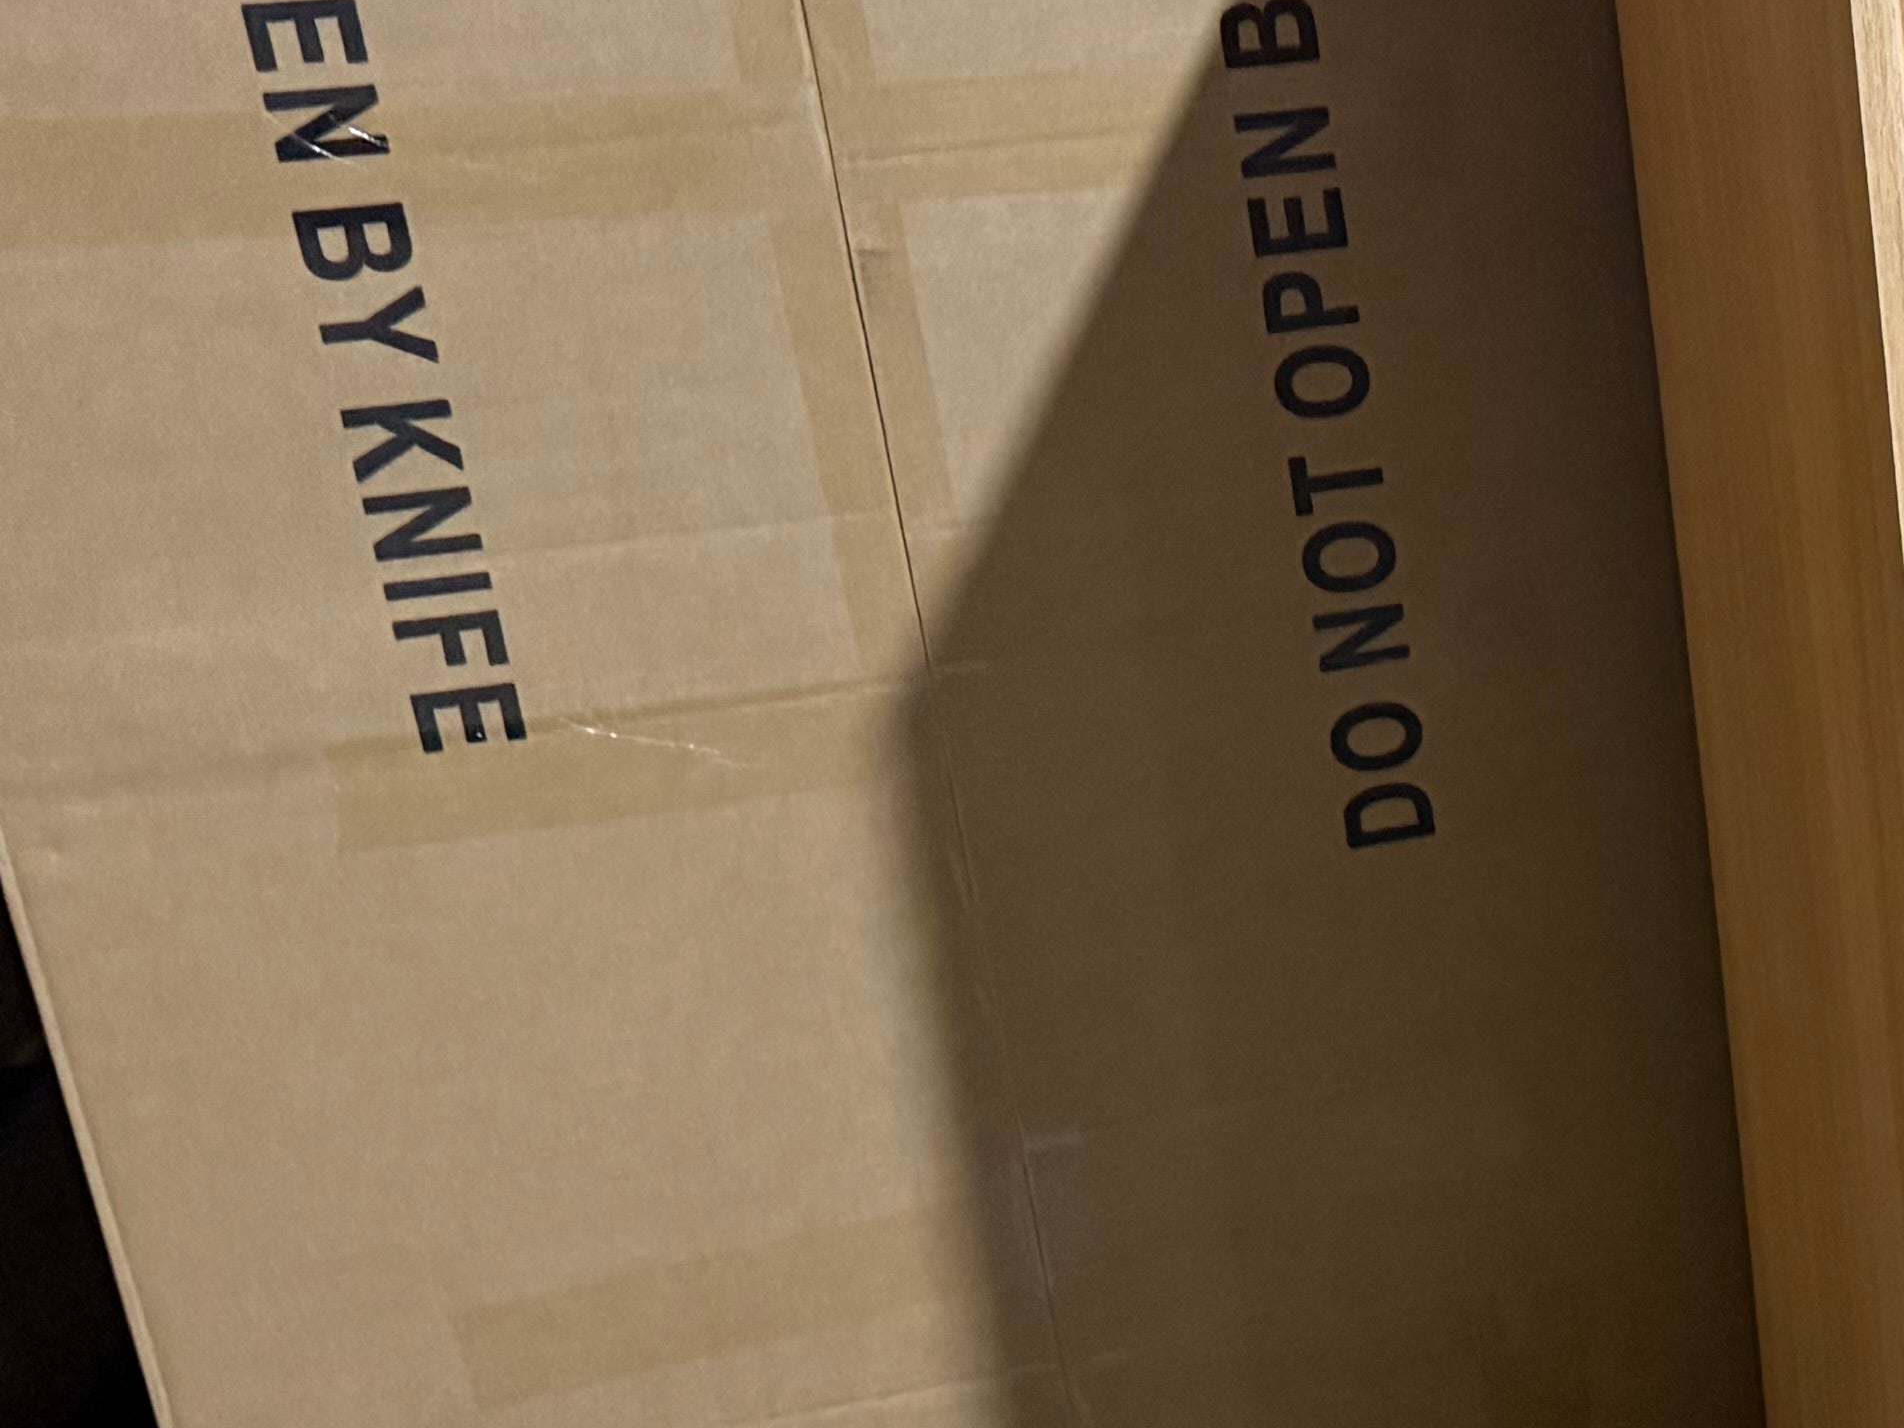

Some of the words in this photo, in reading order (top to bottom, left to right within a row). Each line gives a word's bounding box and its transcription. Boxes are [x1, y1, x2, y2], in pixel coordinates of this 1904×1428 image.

[291, 200, 440, 364] BY
[1232, 105, 1372, 420] OPEN
[340, 397, 528, 755] KNIFE
[1287, 455, 1411, 674] NOT
[1330, 701, 1437, 851] DO
